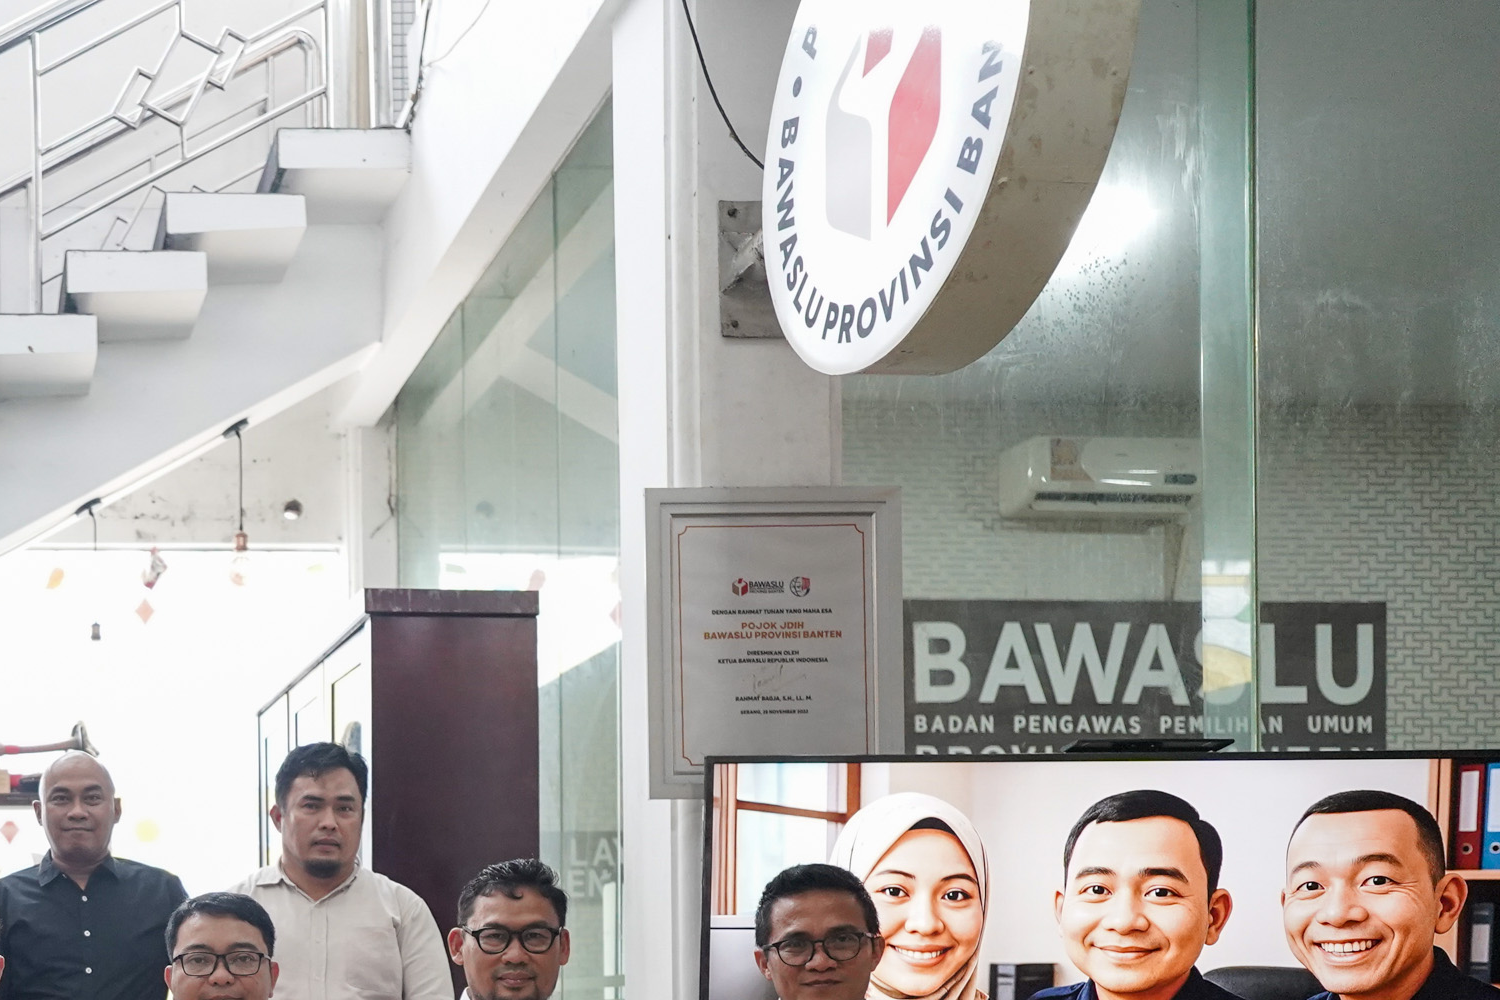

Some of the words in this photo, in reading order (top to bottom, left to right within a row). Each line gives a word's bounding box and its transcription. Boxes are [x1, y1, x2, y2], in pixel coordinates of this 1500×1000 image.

[776, 116, 824, 328] BAWASLU
[821, 187, 964, 344] PROVINSI
[741, 622, 777, 630] POJOK
[780, 621, 804, 630] JDIH
[704, 632, 752, 640] BAWASLU
[754, 631, 800, 639] PROVINSI
[803, 630, 842, 639] BANTEN
[914, 714, 994, 735] BADAN
[1013, 714, 1141, 735] PENGAWAS
[1307, 714, 1373, 734] UMUM
